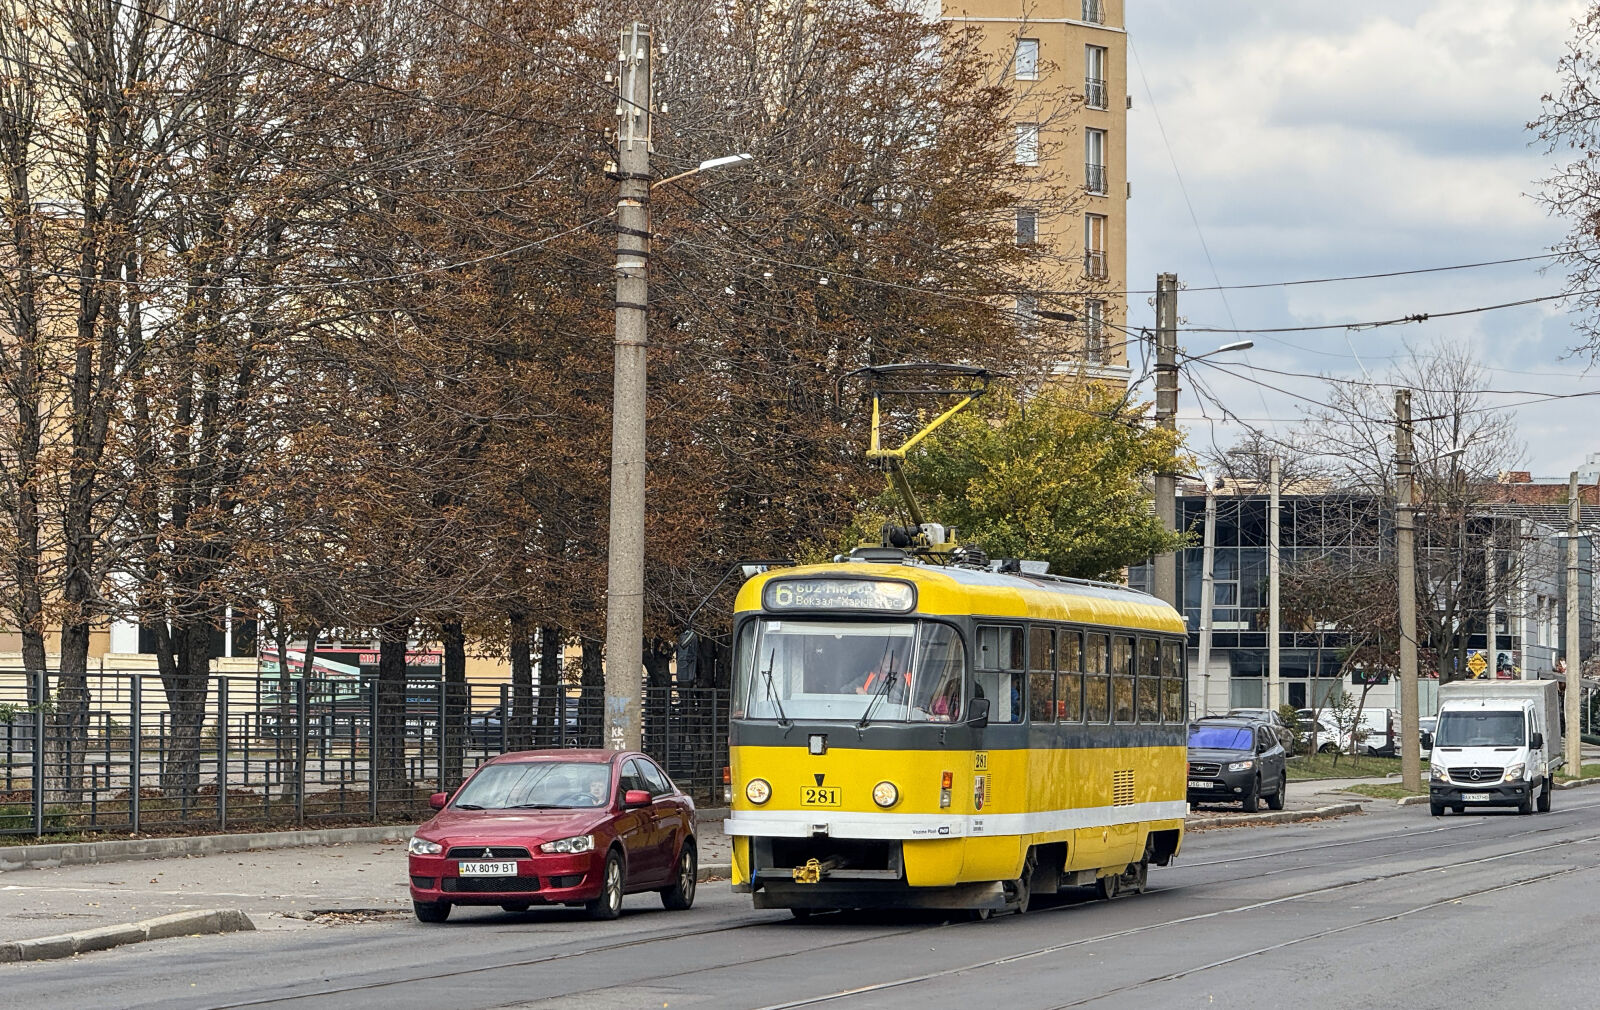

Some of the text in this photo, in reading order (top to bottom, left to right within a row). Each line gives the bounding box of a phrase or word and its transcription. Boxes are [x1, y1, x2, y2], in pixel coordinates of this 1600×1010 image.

[776, 583, 792, 606] 6
[975, 754, 987, 768] 281
[806, 789, 836, 804] 281
[465, 864, 515, 872] AX 8019 BT
